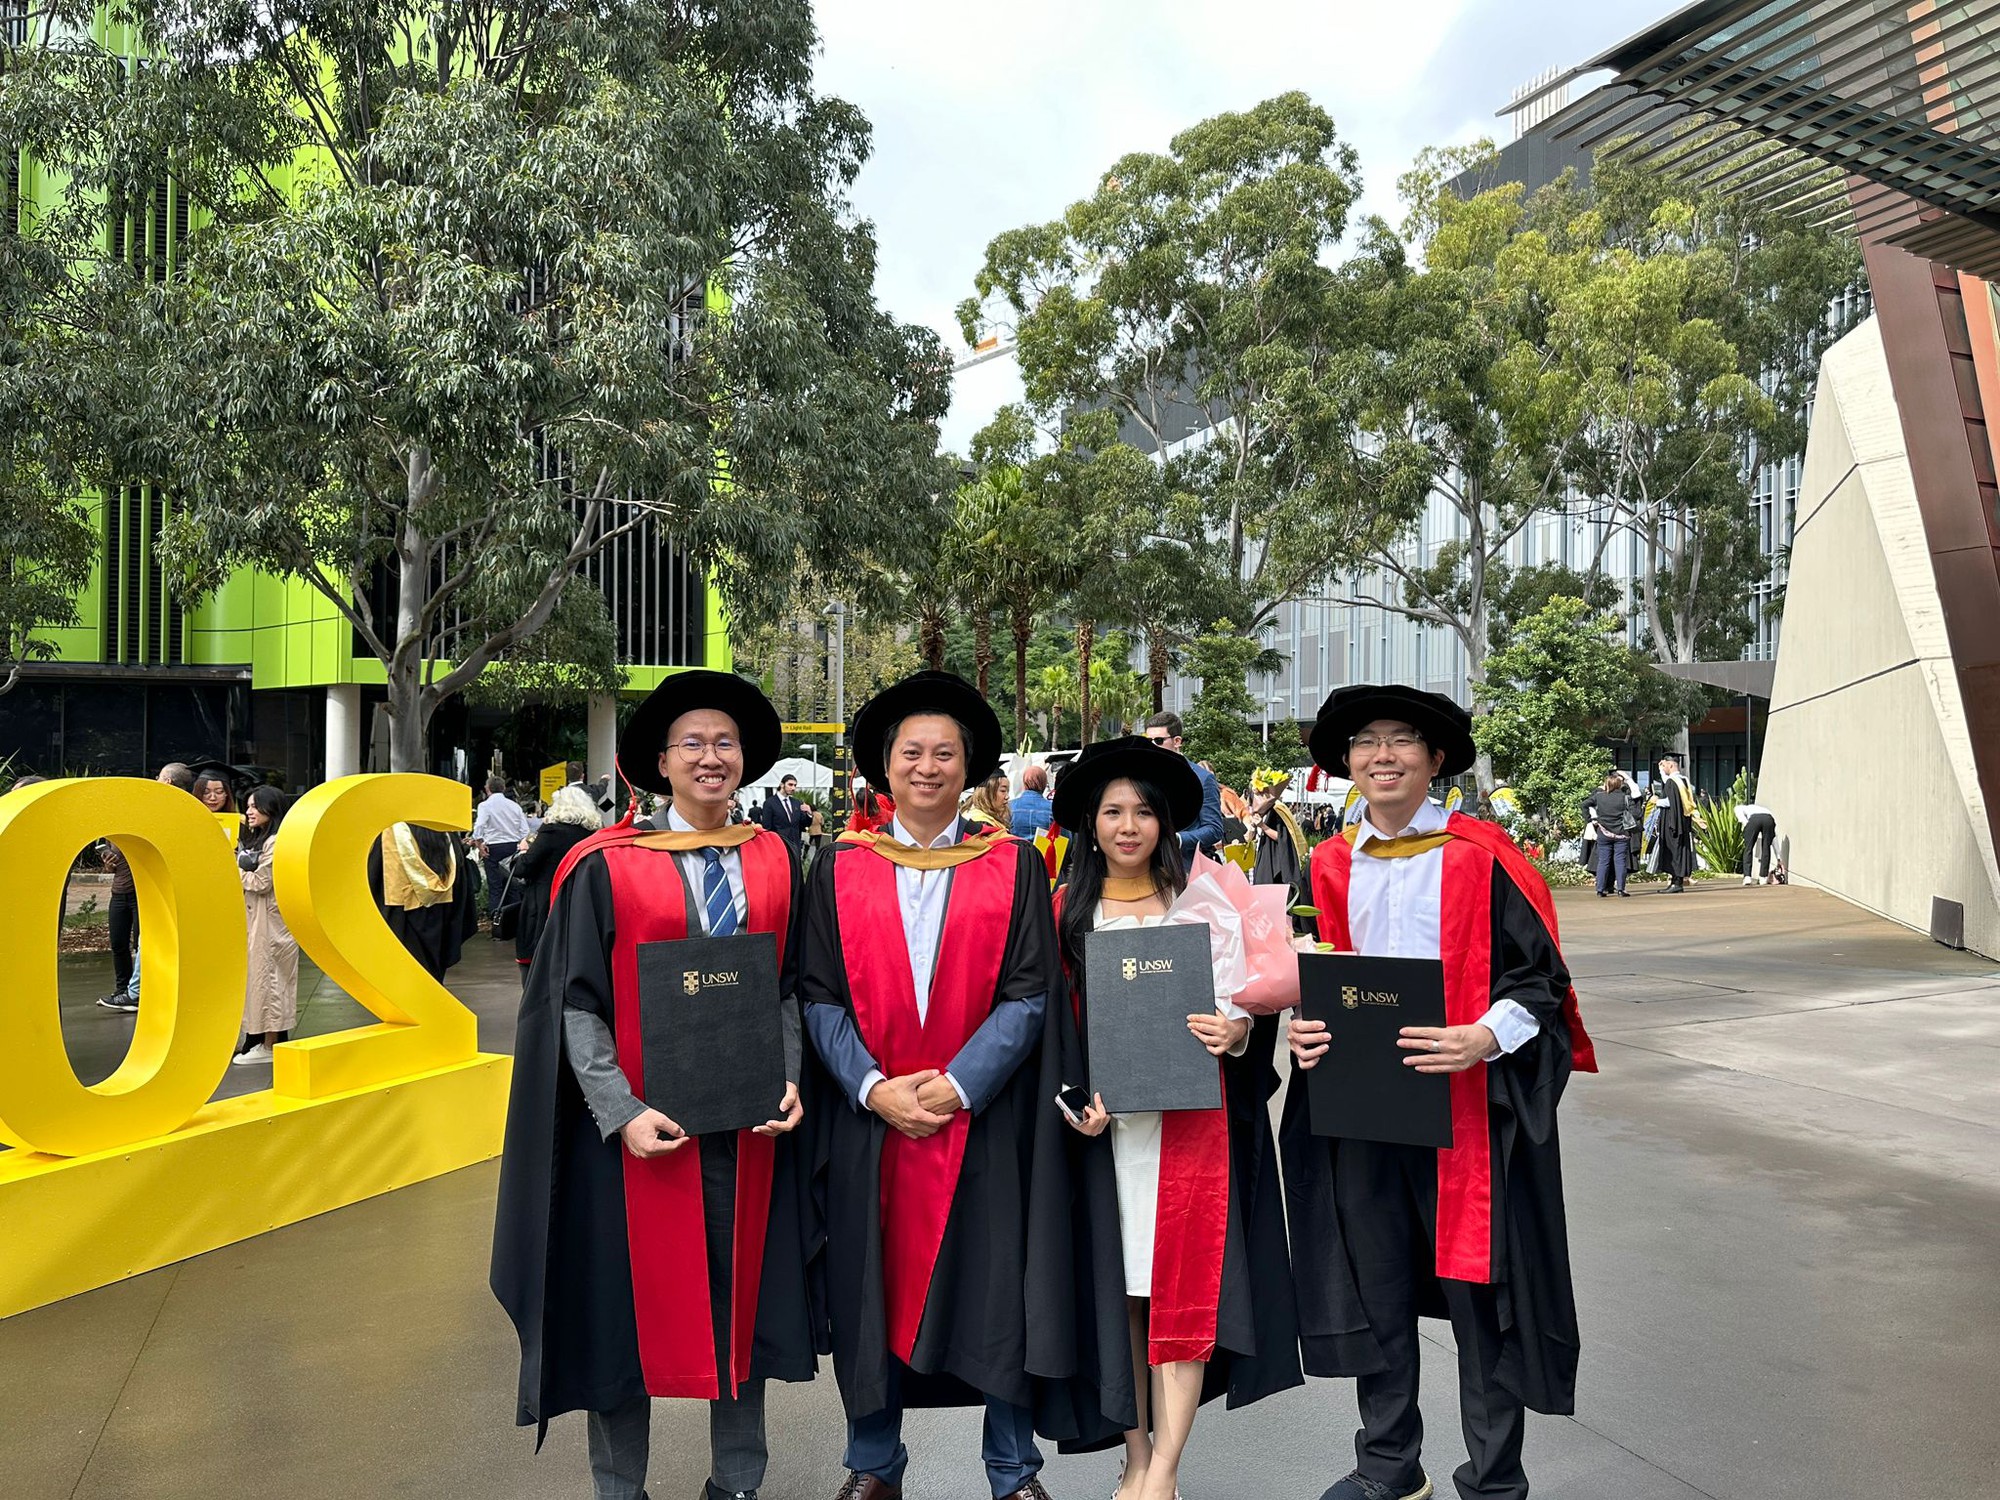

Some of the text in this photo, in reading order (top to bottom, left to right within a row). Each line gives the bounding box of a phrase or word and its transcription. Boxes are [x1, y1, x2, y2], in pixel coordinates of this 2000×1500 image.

[1139, 959, 1173, 971] UNSW
[702, 971, 739, 984] UNSW
[1361, 991, 1398, 1003] UNSW
